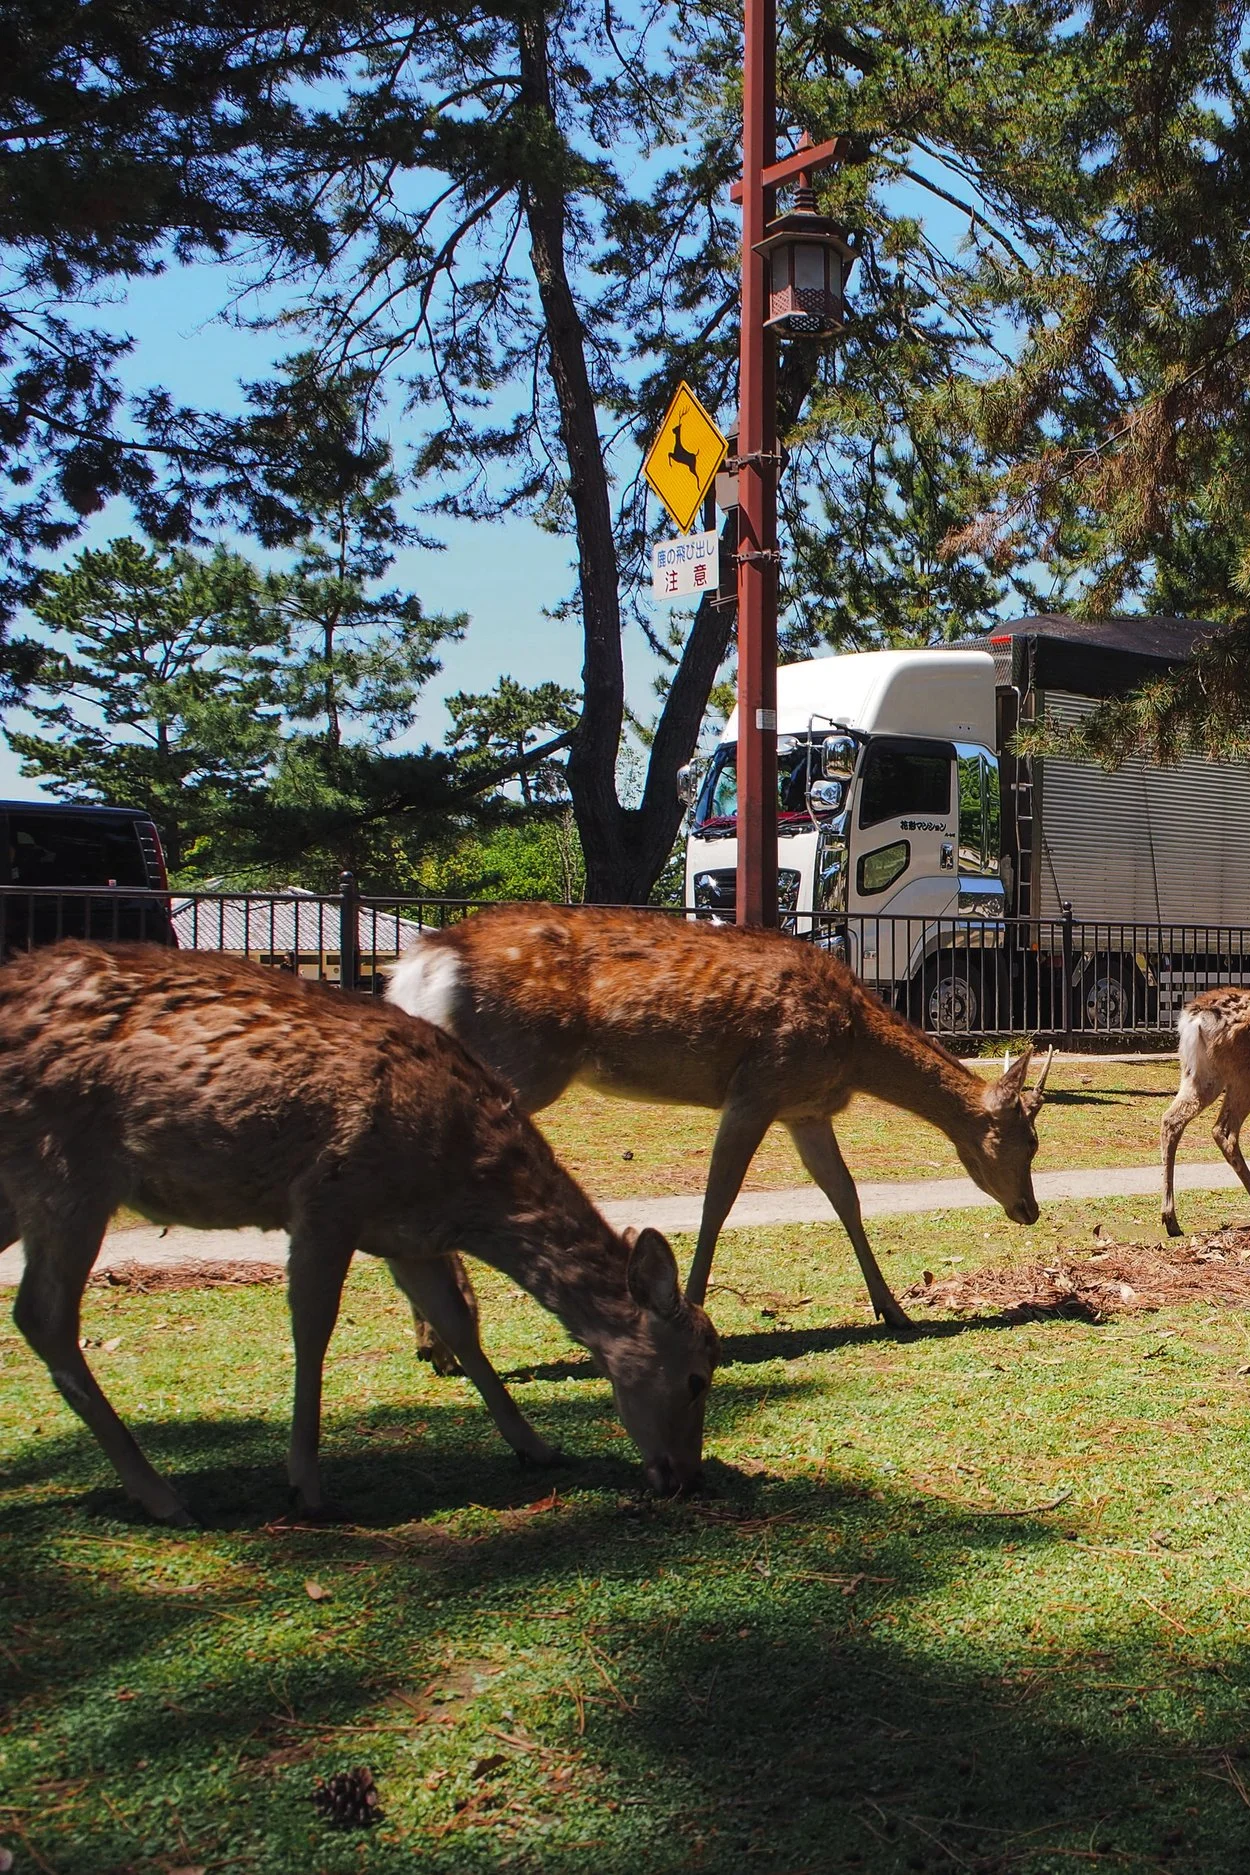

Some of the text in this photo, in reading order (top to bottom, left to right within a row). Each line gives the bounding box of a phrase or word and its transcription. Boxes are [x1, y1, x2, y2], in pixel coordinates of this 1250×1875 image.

[657, 539, 715, 568] 鹿の飛び出し
[665, 564, 708, 593] 注意
